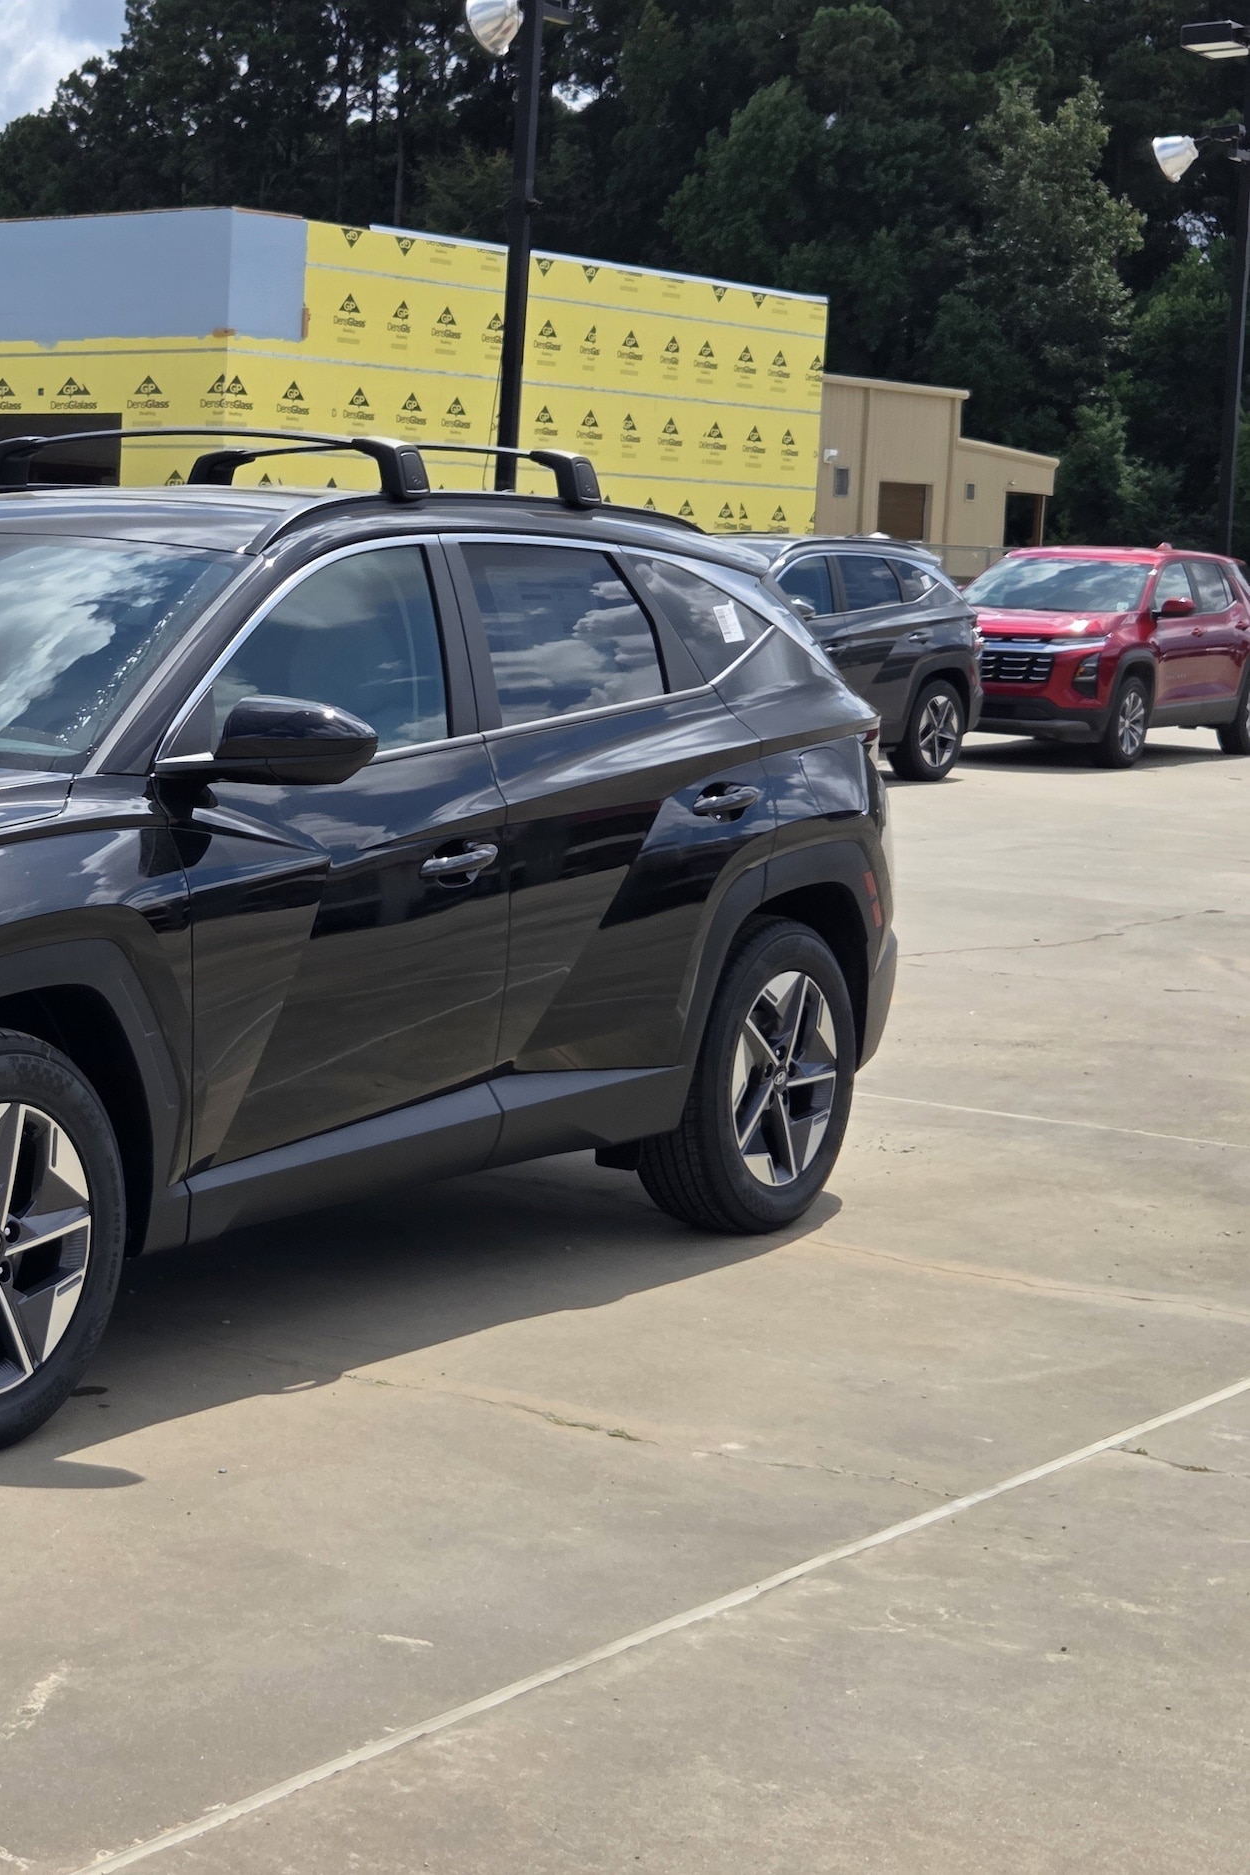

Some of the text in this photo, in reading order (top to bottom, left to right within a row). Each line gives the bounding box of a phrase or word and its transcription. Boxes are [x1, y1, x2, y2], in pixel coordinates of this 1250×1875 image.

[343, 301, 355, 311] GP
[334, 316, 366, 328] DensGlass
[432, 329, 462, 340] DensGlass
[140, 383, 156, 393] GP
[229, 383, 243, 393] GP
[287, 389, 299, 399] GP
[126, 399, 170, 409] DensGlass
[352, 395, 365, 405] GP
[405, 400, 418, 409] GP
[276, 403, 310, 415] DensGlass
[343, 410, 375, 421] DensGlass
[396, 415, 427, 425] DensGlass
